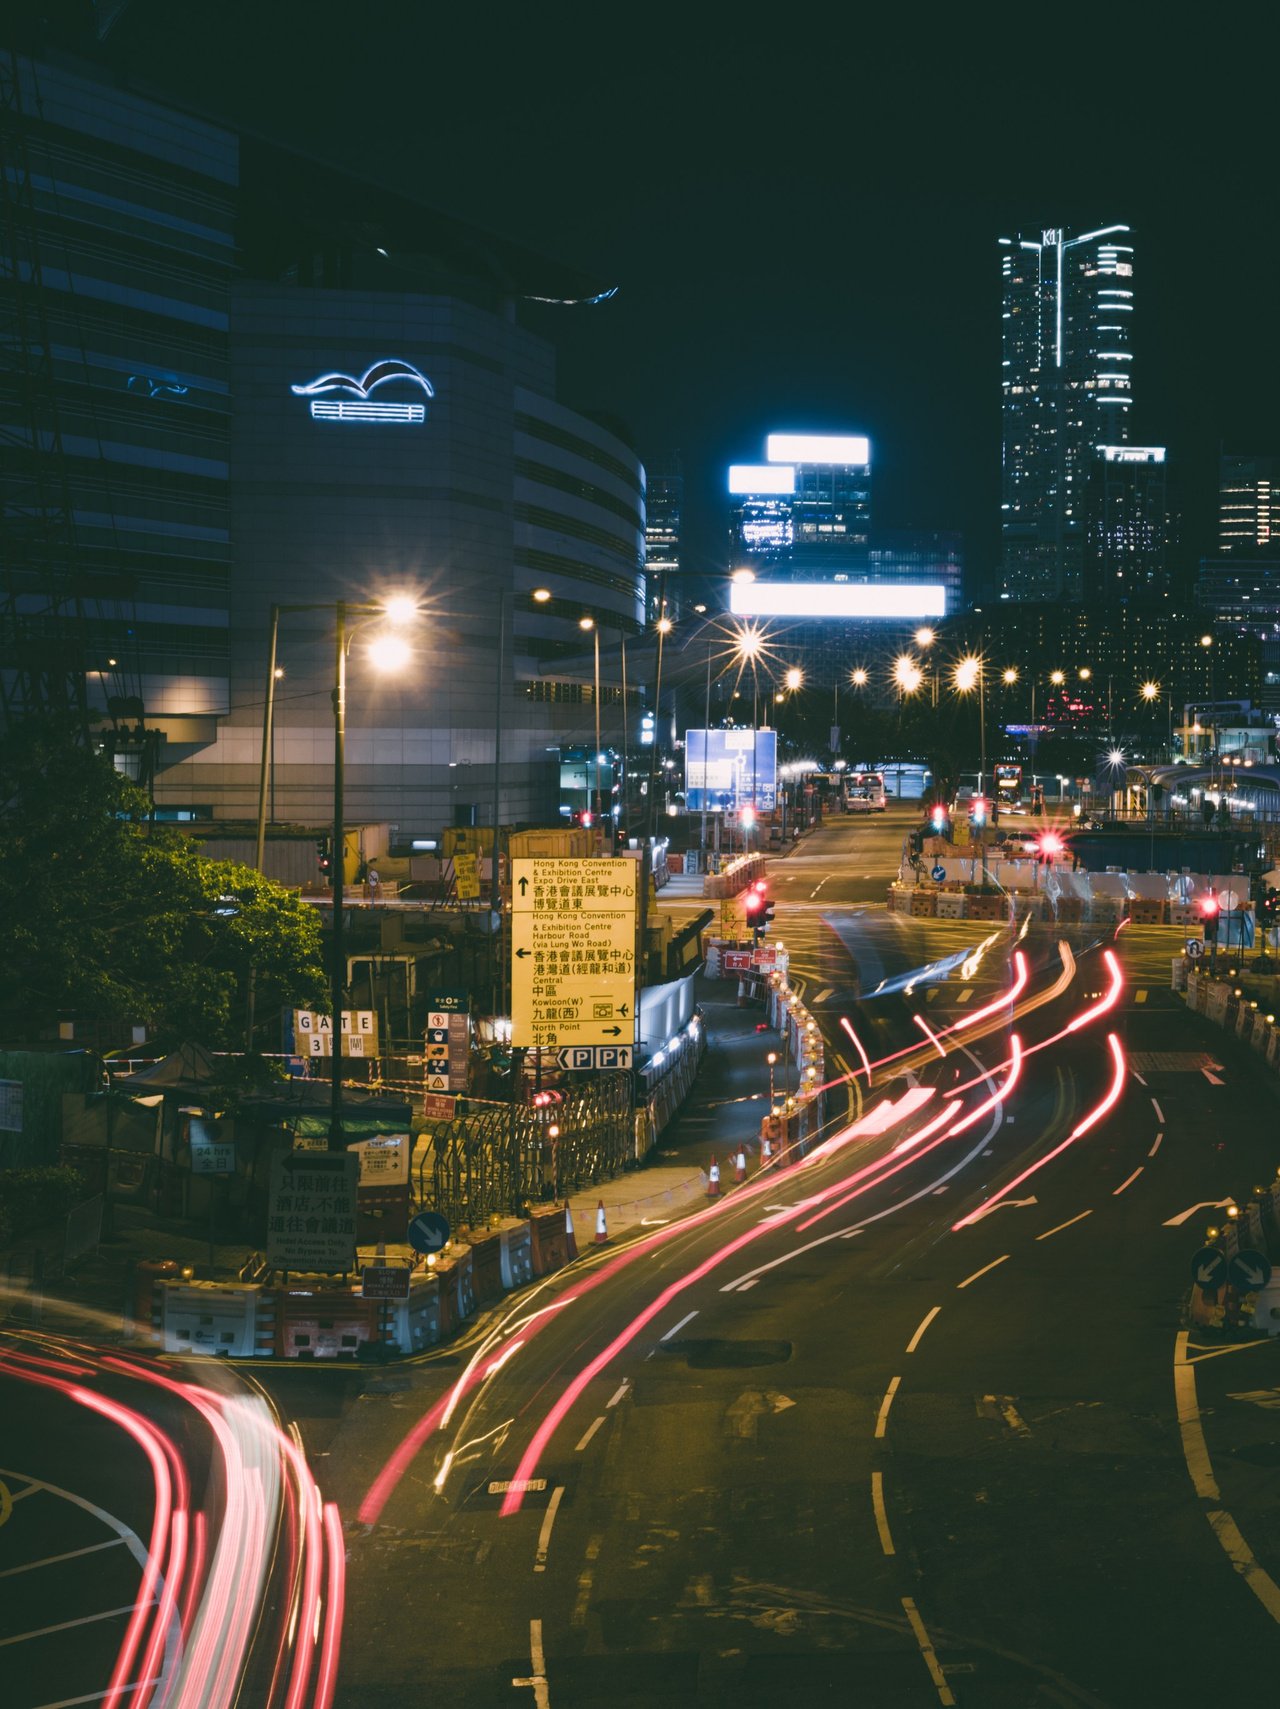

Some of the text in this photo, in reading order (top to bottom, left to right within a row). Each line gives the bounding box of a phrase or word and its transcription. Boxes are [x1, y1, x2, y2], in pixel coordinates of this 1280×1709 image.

[533, 860, 627, 869] Hong Kong Convention
[541, 868, 580, 876] Exhibition
[582, 868, 612, 876] Centre
[533, 876, 599, 885] Expo Drive East
[533, 885, 635, 898] 香港會議展覽中心
[533, 898, 583, 910] 博覽道東
[532, 912, 554, 921] Hong
[558, 912, 578, 920] Kong
[541, 923, 580, 931] Exhibition
[532, 931, 590, 940] Harbour Road
[532, 940, 549, 949] (via
[551, 940, 569, 949] Lung
[586, 939, 612, 948] Road)
[533, 949, 634, 962] 香港會議展覽中心
[533, 962, 632, 976] 港灣道(經龍和道)
[532, 985, 557, 997] 中區
[532, 998, 584, 1007] Kowloon(W)
[532, 1007, 579, 1020] 九龍(西)
[532, 1023, 581, 1031] North Point
[532, 1033, 557, 1045] 北角
[576, 1051, 589, 1064] P
[602, 1051, 615, 1064] P
[197, 1147, 231, 1156] 24 hrs
[201, 1157, 227, 1169] 全日
[279, 1174, 349, 1193] 只限前往
[268, 1215, 355, 1234] 通往會議道
[276, 1237, 296, 1245] Hotel
[297, 1238, 325, 1246] Access
[298, 1247, 326, 1256] Bypass
[328, 1248, 338, 1256] To
[272, 1256, 347, 1265] Convention Avenue
